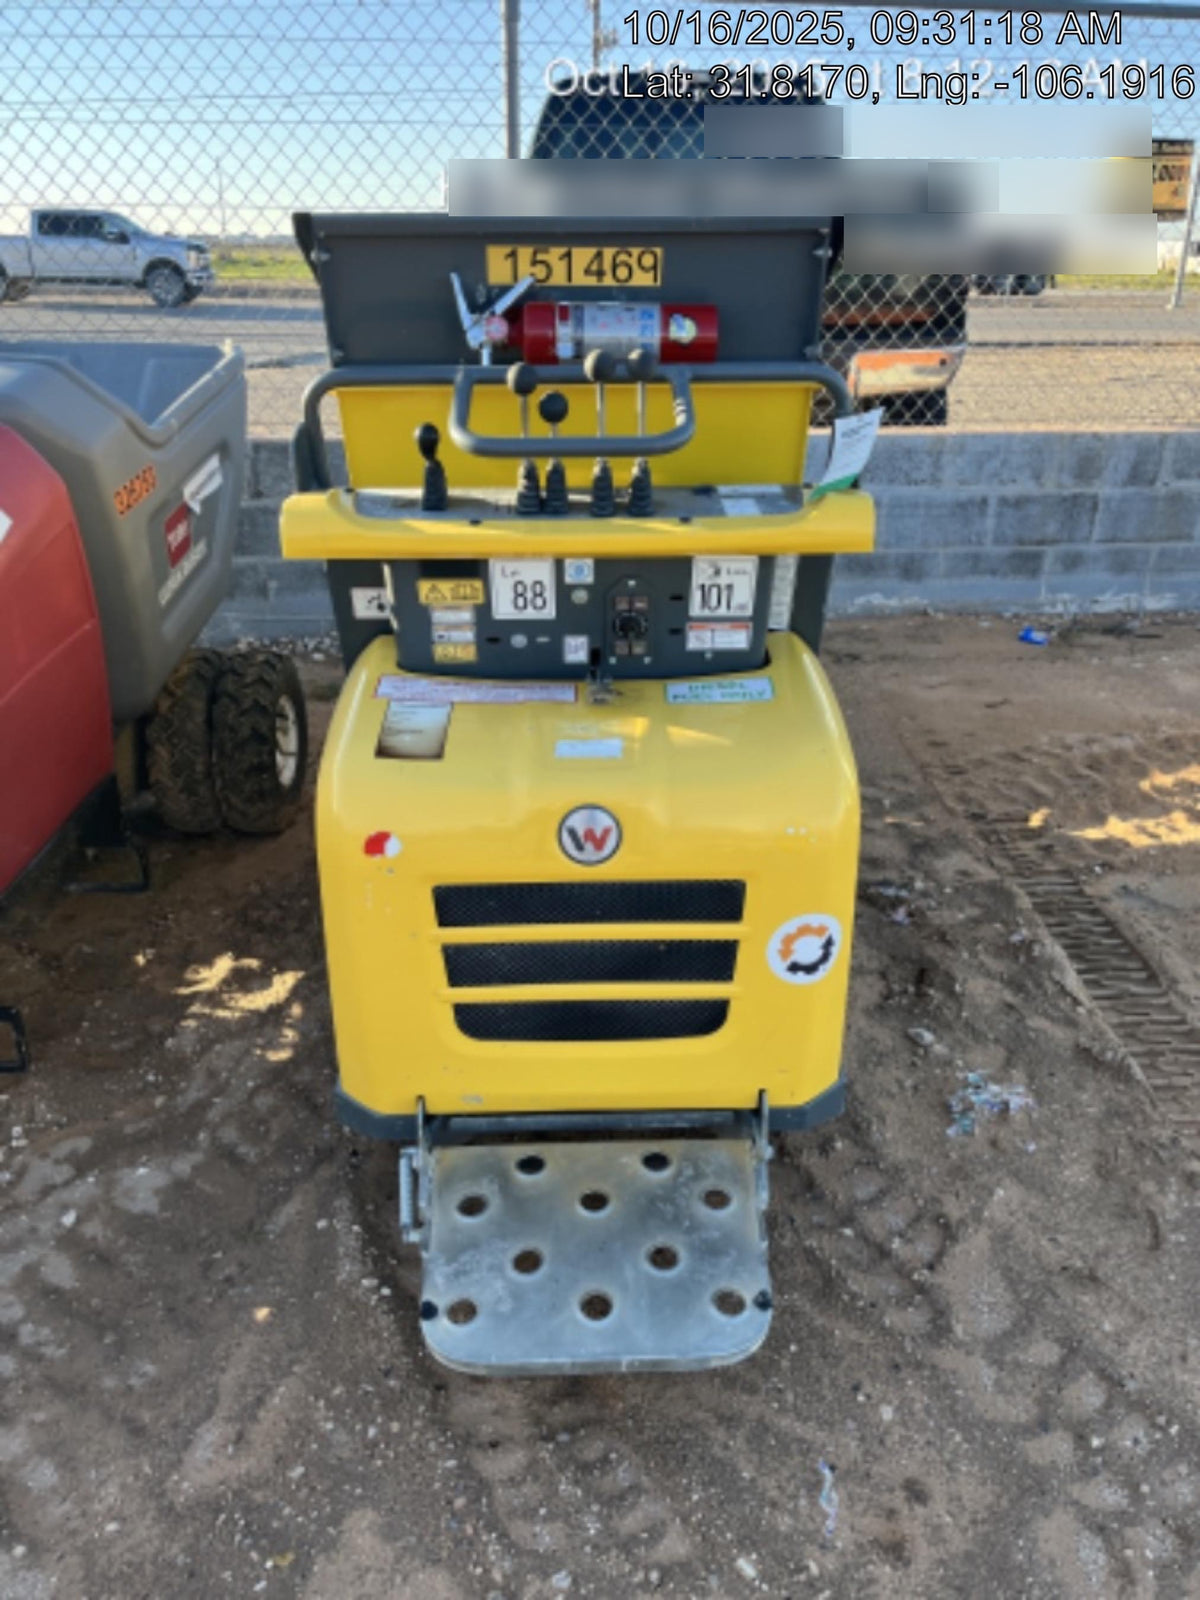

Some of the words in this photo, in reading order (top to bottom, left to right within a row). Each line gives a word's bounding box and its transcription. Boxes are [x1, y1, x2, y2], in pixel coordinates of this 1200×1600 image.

[504, 248, 658, 284] 151469
[512, 580, 547, 611] 88
[696, 582, 735, 611] 101
